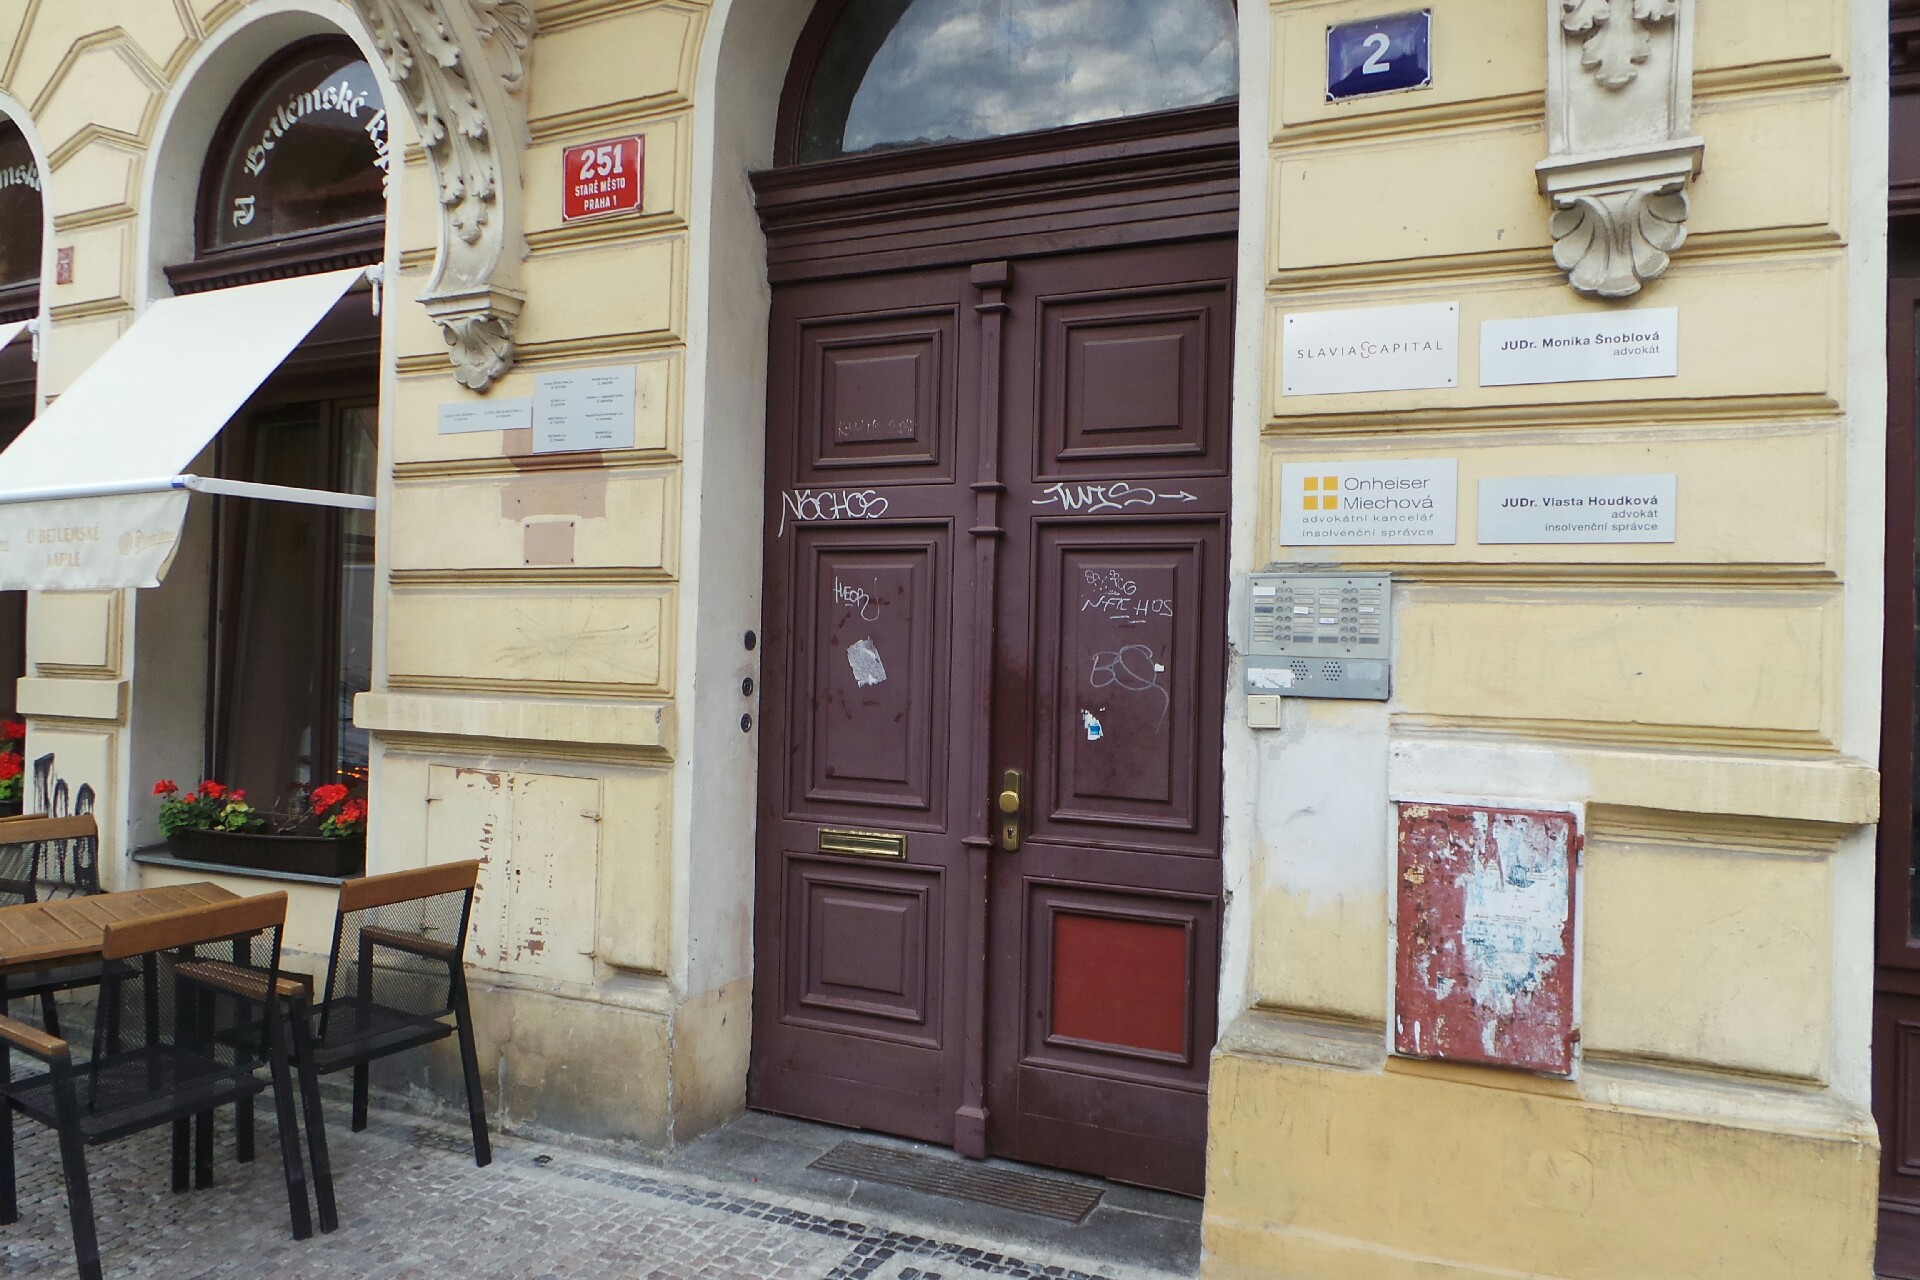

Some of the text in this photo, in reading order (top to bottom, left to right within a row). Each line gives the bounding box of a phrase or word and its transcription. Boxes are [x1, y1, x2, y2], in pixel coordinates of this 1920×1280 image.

[1362, 32, 1391, 75] 2
[579, 143, 623, 180] 251
[574, 176, 626, 197] STARÉ MĚSTO
[583, 194, 618, 211] PRAHA 1
[1501, 331, 1660, 351] JUDr. Monika Šnoblová
[1297, 340, 1443, 359] SLAVIA CAPITAL
[1613, 345, 1660, 356] advokát
[1344, 476, 1431, 491] Onheiser
[1343, 495, 1434, 510] Miechová
[1501, 495, 1659, 508] JUDr. Vlasta Houdková
[1302, 513, 1434, 523] advokátní kancelář
[1611, 509, 1659, 519] advokát
[1302, 528, 1434, 538] insolvenční správce
[1545, 521, 1659, 533] insolvenční správce
